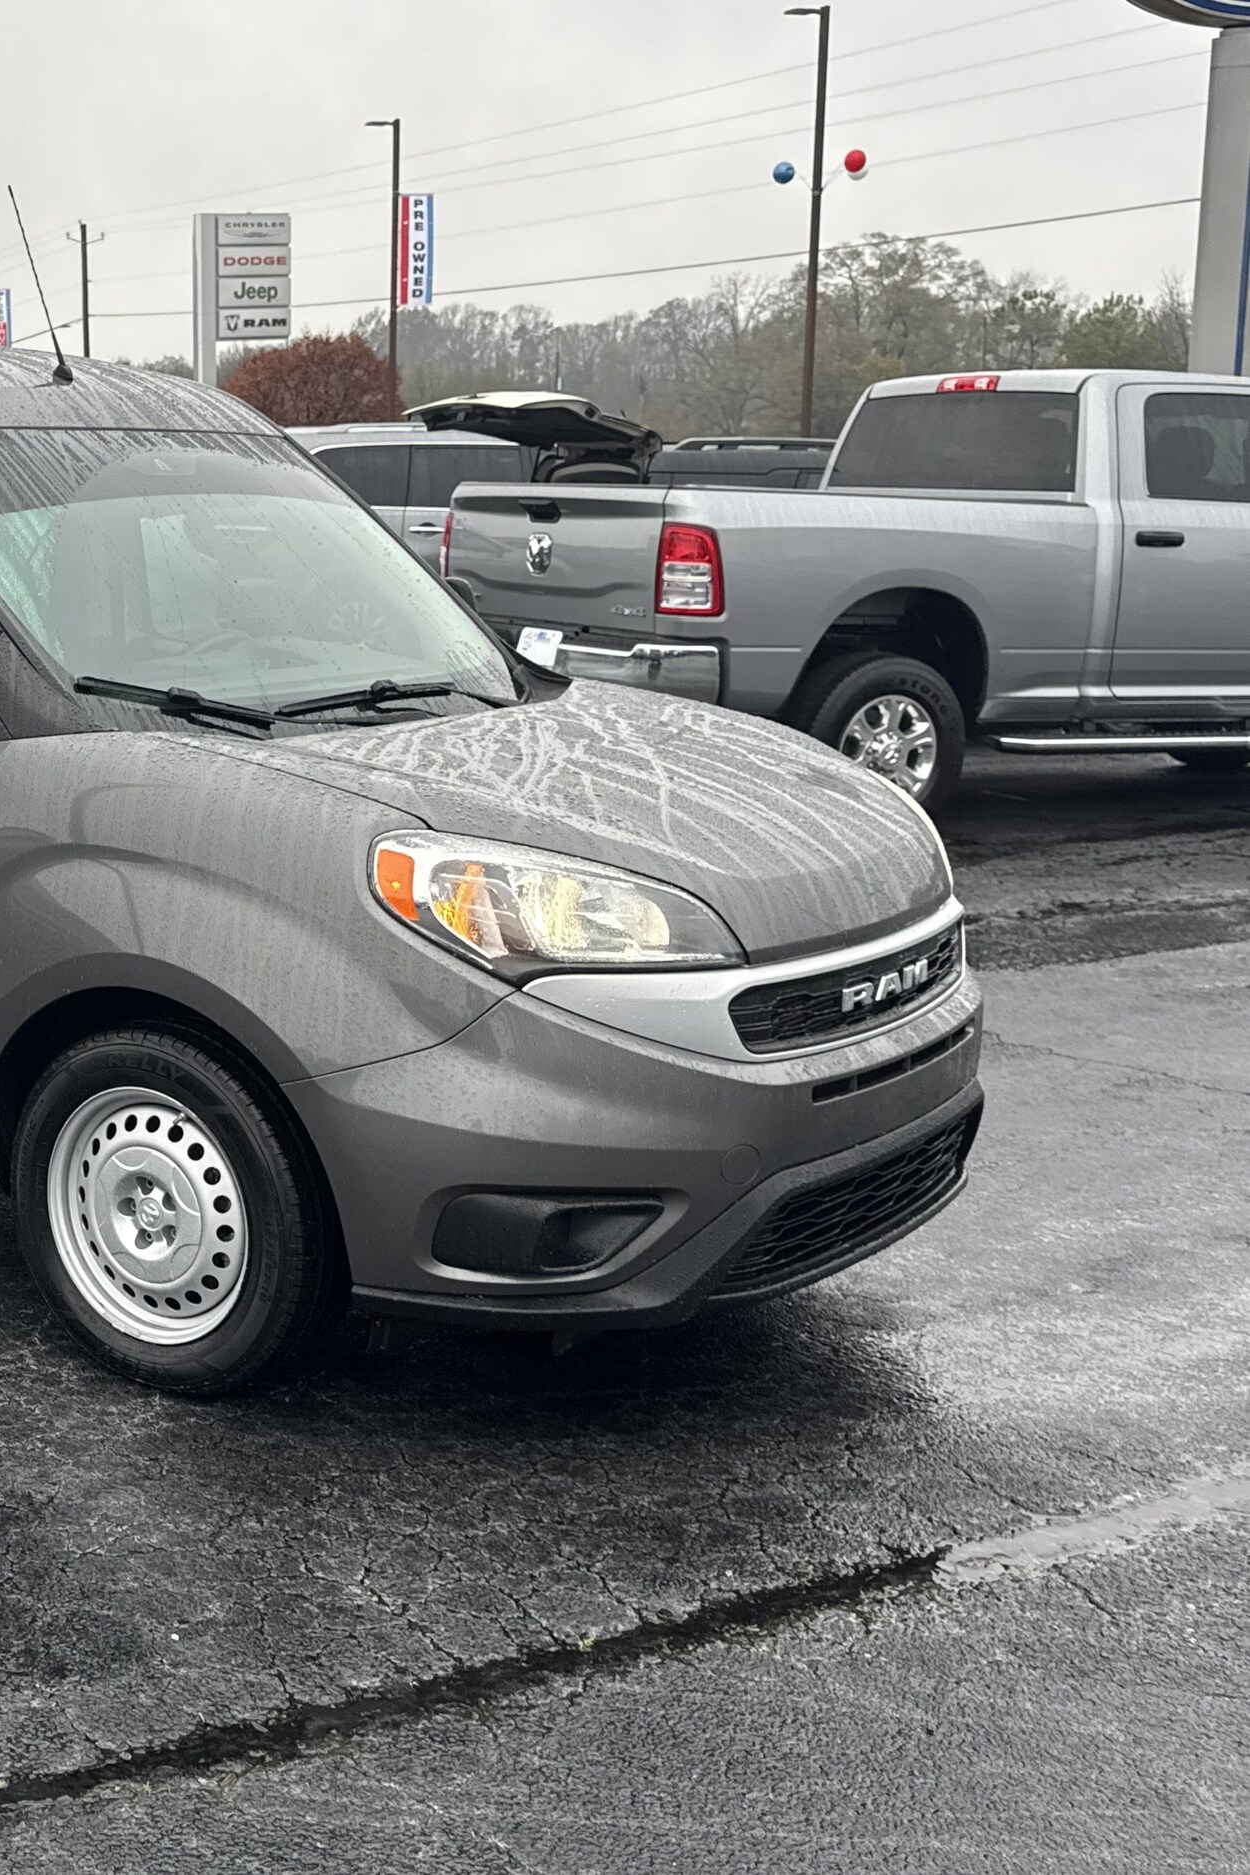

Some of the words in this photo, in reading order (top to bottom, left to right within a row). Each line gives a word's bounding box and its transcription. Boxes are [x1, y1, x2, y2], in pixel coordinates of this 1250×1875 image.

[413, 199, 424, 232] PRE
[223, 256, 287, 266] DODGE
[412, 242, 426, 298] OWNED
[233, 282, 278, 302] Jeep
[243, 318, 287, 328] RAM
[842, 958, 928, 1013] RAM
[107, 1053, 188, 1081] KELLY
